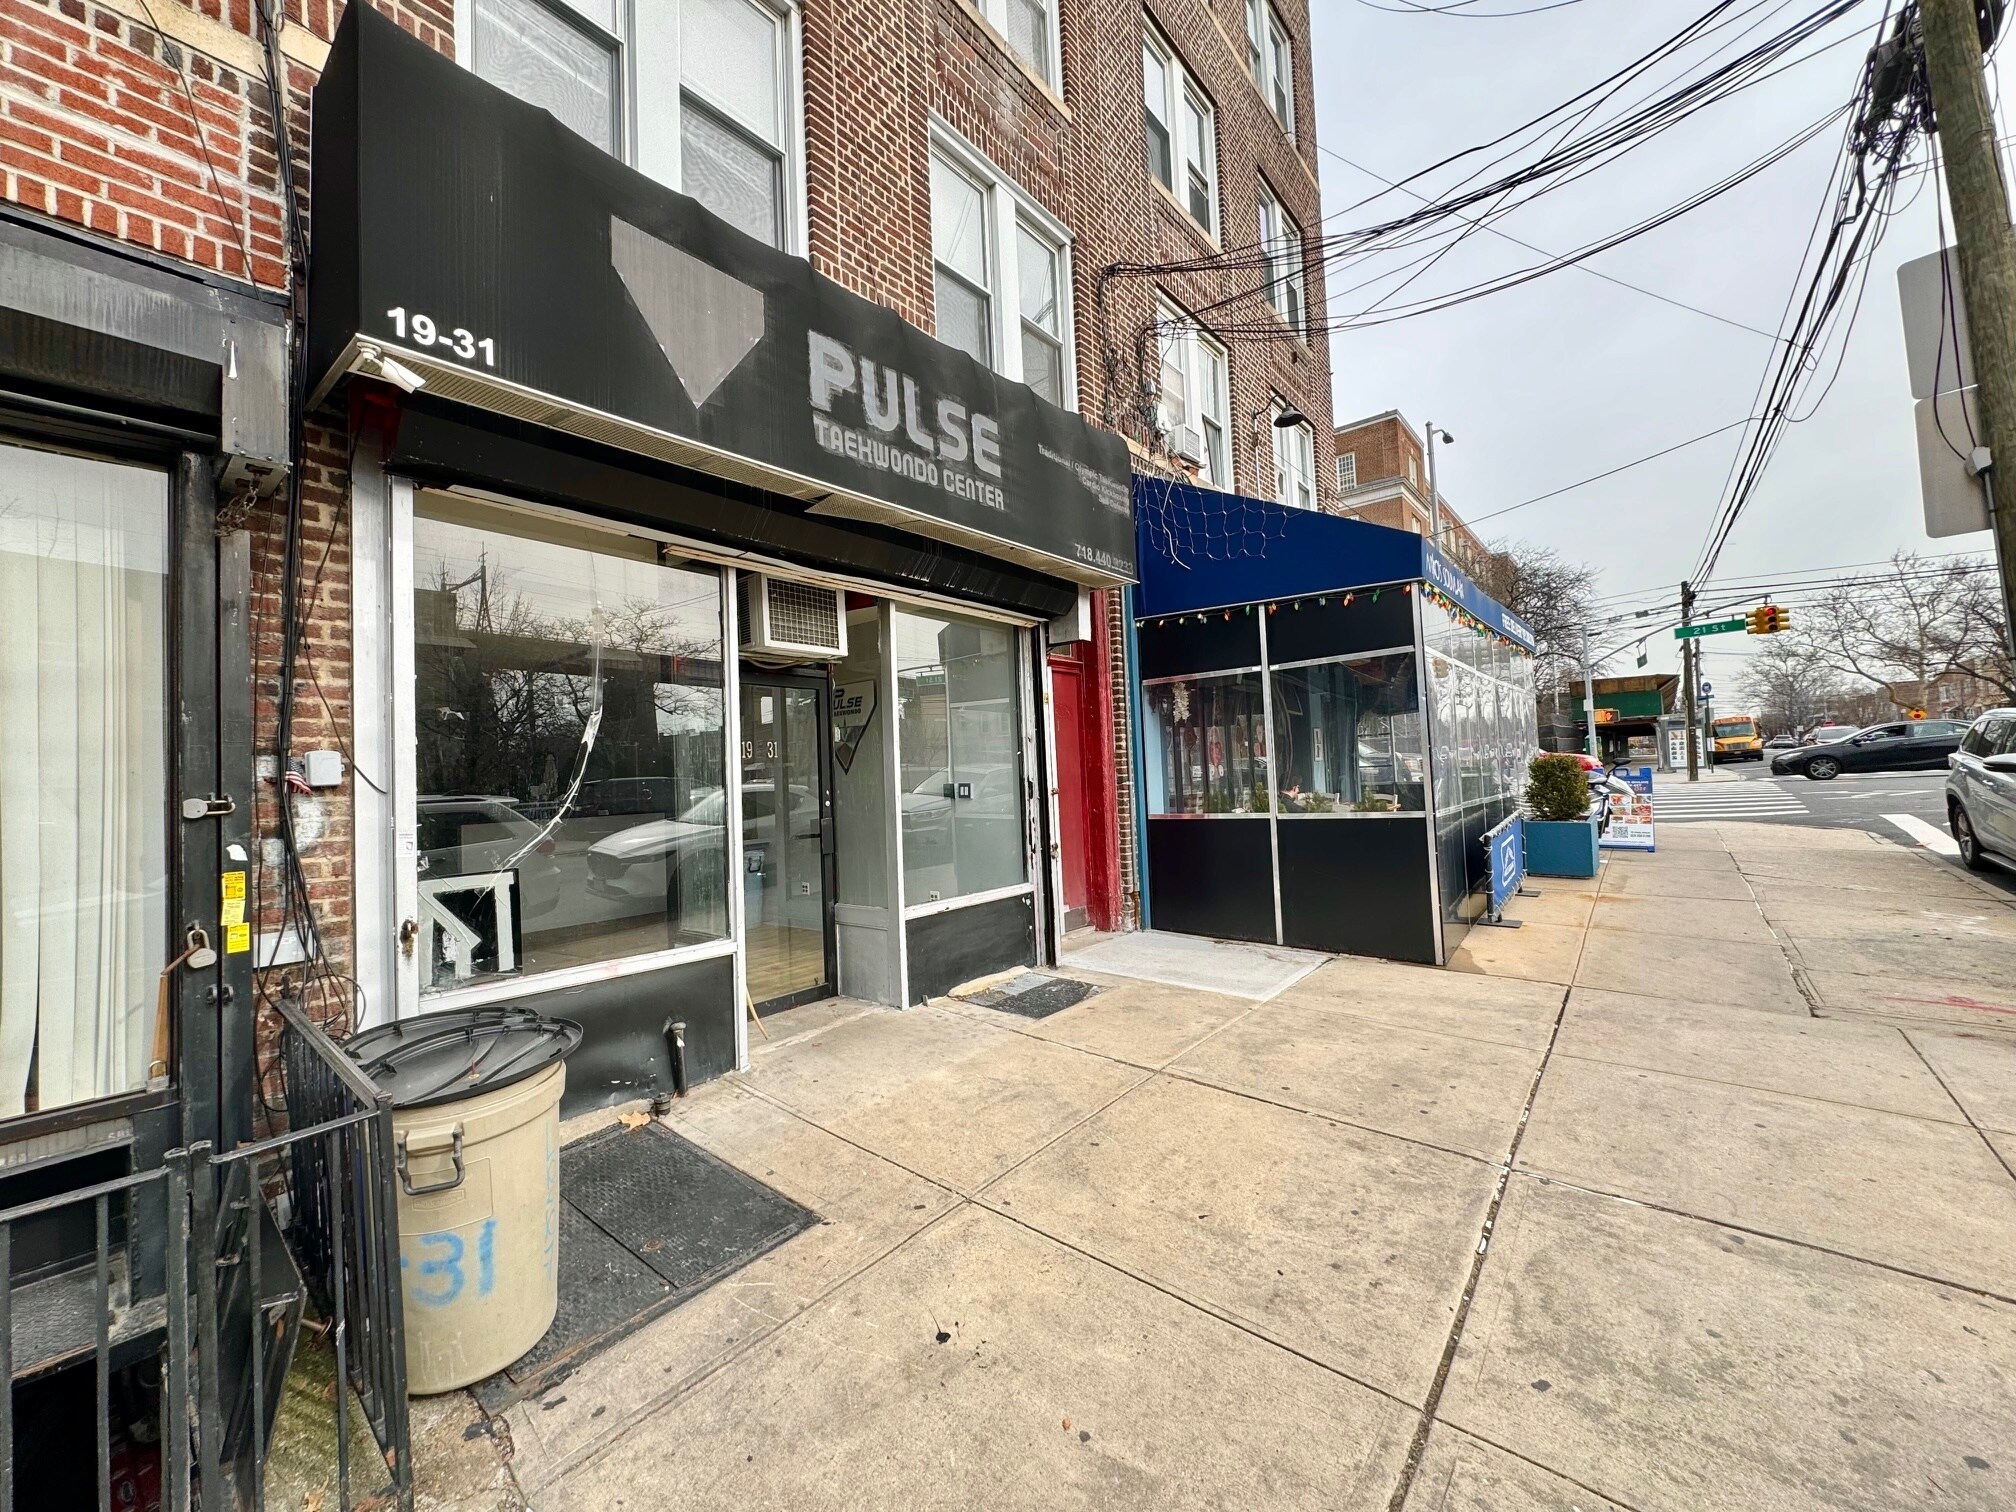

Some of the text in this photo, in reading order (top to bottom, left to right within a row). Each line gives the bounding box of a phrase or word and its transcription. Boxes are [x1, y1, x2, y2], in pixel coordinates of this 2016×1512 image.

[387, 306, 495, 368] 19-31
[808, 329, 1002, 478] PULSE
[813, 413, 1005, 511] TAEKWONDO CENTER
[1693, 623, 1726, 635] 21 St
[741, 741, 779, 759] 19 31
